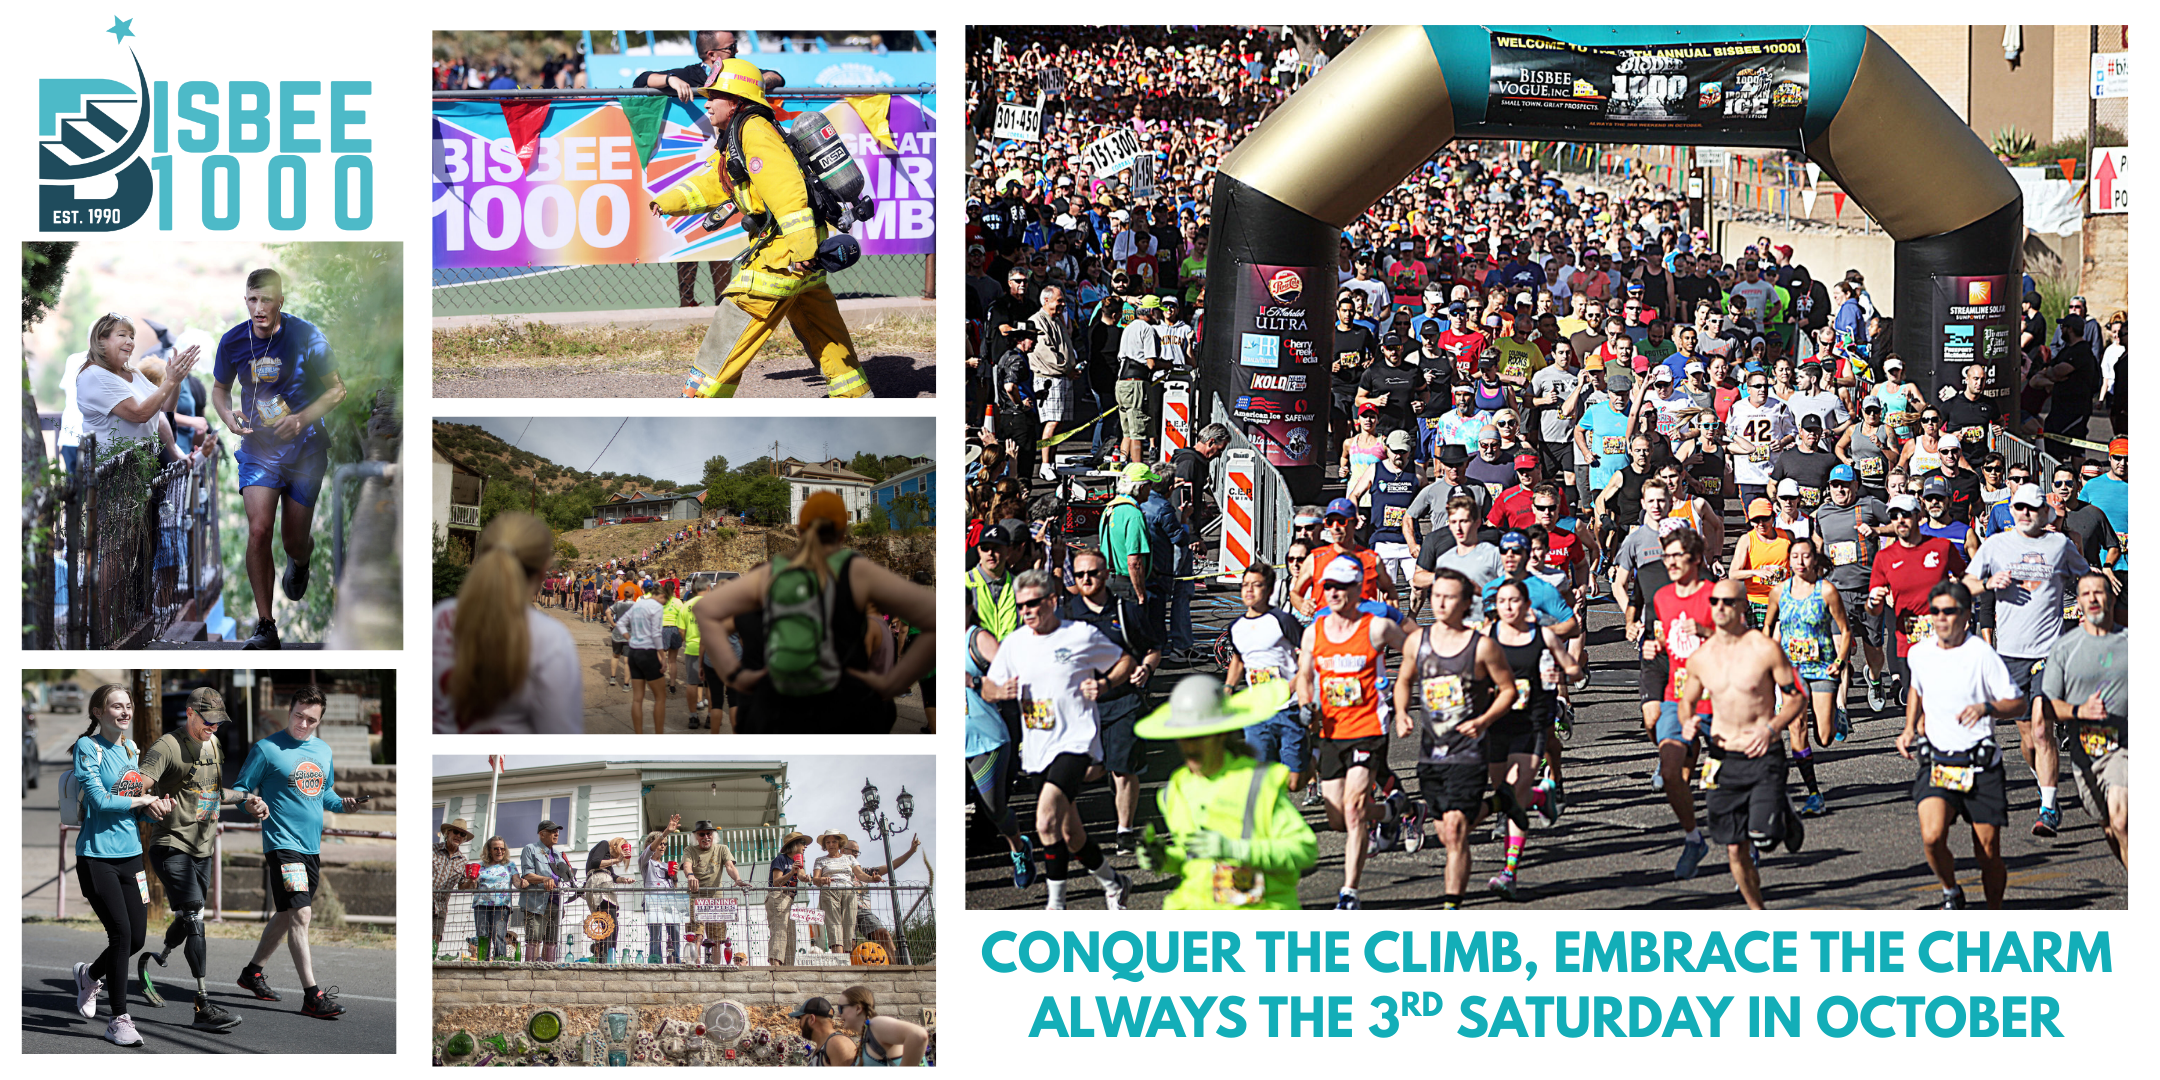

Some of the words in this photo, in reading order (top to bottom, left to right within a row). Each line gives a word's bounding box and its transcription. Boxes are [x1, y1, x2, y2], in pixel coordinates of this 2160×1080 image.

[1657, 47, 1711, 58] ANNUAL
[1714, 45, 1762, 57] BISBEE
[1763, 43, 1801, 55] 1000!
[1520, 68, 1572, 85] BISBEE
[1551, 88, 1571, 97] INC.
[1723, 99, 1769, 115] ICE
[997, 106, 1040, 133] 301-450
[1089, 129, 1139, 168] 151-300
[432, 135, 633, 183] BISBEE
[821, 147, 846, 168] MSA
[860, 156, 935, 199] AIR
[432, 182, 631, 251] 1000
[1266, 306, 1306, 317] Michelob
[1950, 305, 1989, 315] STREAMLINE
[1989, 304, 2006, 314] SOLAR
[1255, 316, 1308, 330] ULTRA
[1258, 336, 1278, 357] HR
[1283, 338, 1313, 350] Cherry
[1289, 347, 1313, 356] Creek
[1508, 349, 1529, 358] COLORADO
[1295, 355, 1318, 364] Media
[1253, 374, 1288, 391] KOLD
[1287, 381, 1297, 391] 13
[260, 402, 283, 419] 105
[1233, 409, 1269, 419] American
[1270, 412, 1281, 420] Ice
[1242, 416, 1271, 425] Company
[1284, 414, 1315, 422] SAFEWAY
[1743, 419, 1772, 443] 42
[1703, 480, 1718, 489] 108
[295, 769, 323, 781] Bisbee
[301, 779, 320, 790] 1000
[924, 1010, 936, 1025] 2
